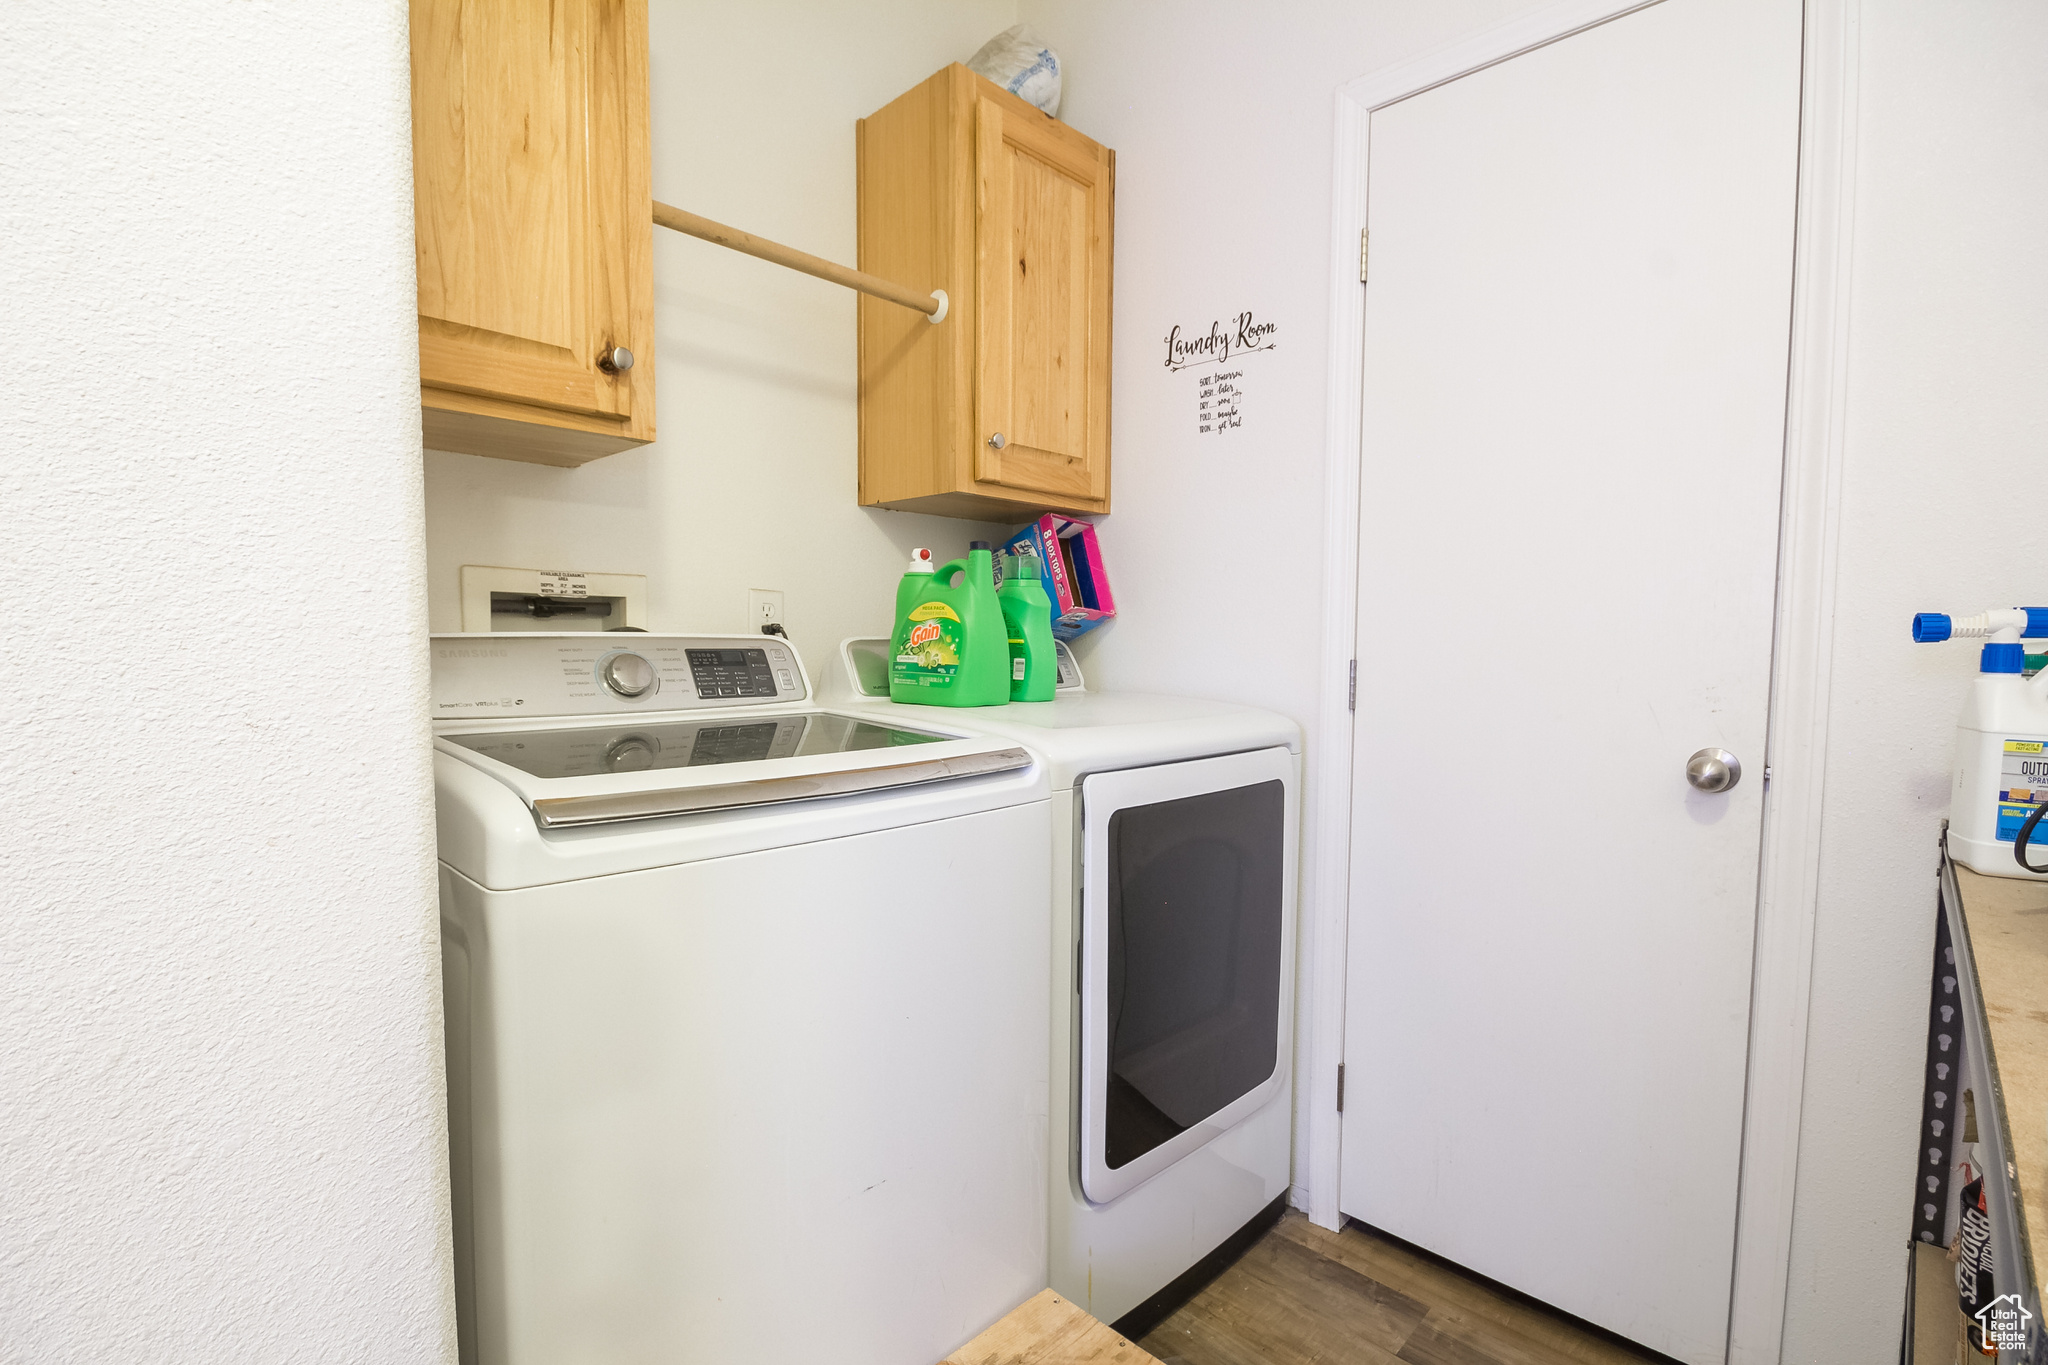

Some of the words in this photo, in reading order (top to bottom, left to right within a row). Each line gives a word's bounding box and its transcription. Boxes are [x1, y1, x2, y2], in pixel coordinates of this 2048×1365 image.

[1164, 320, 1235, 366] Laundry
[1233, 312, 1278, 348] Room
[1214, 370, 1243, 383] tomorrow
[1200, 389, 1214, 399] WASH
[1217, 384, 1234, 395] later
[1200, 402, 1209, 410] DRY
[1200, 412, 1211, 422] FOLD
[1218, 406, 1238, 421] maybe
[1199, 425, 1211, 433] IRON
[1218, 421, 1228, 434] get
[1043, 529, 1053, 539] 8
[1045, 539, 1057, 559] BOX
[1051, 556, 1064, 581] TOPS
[911, 623, 940, 646] Gain
[439, 649, 508, 659] SAMSUNG
